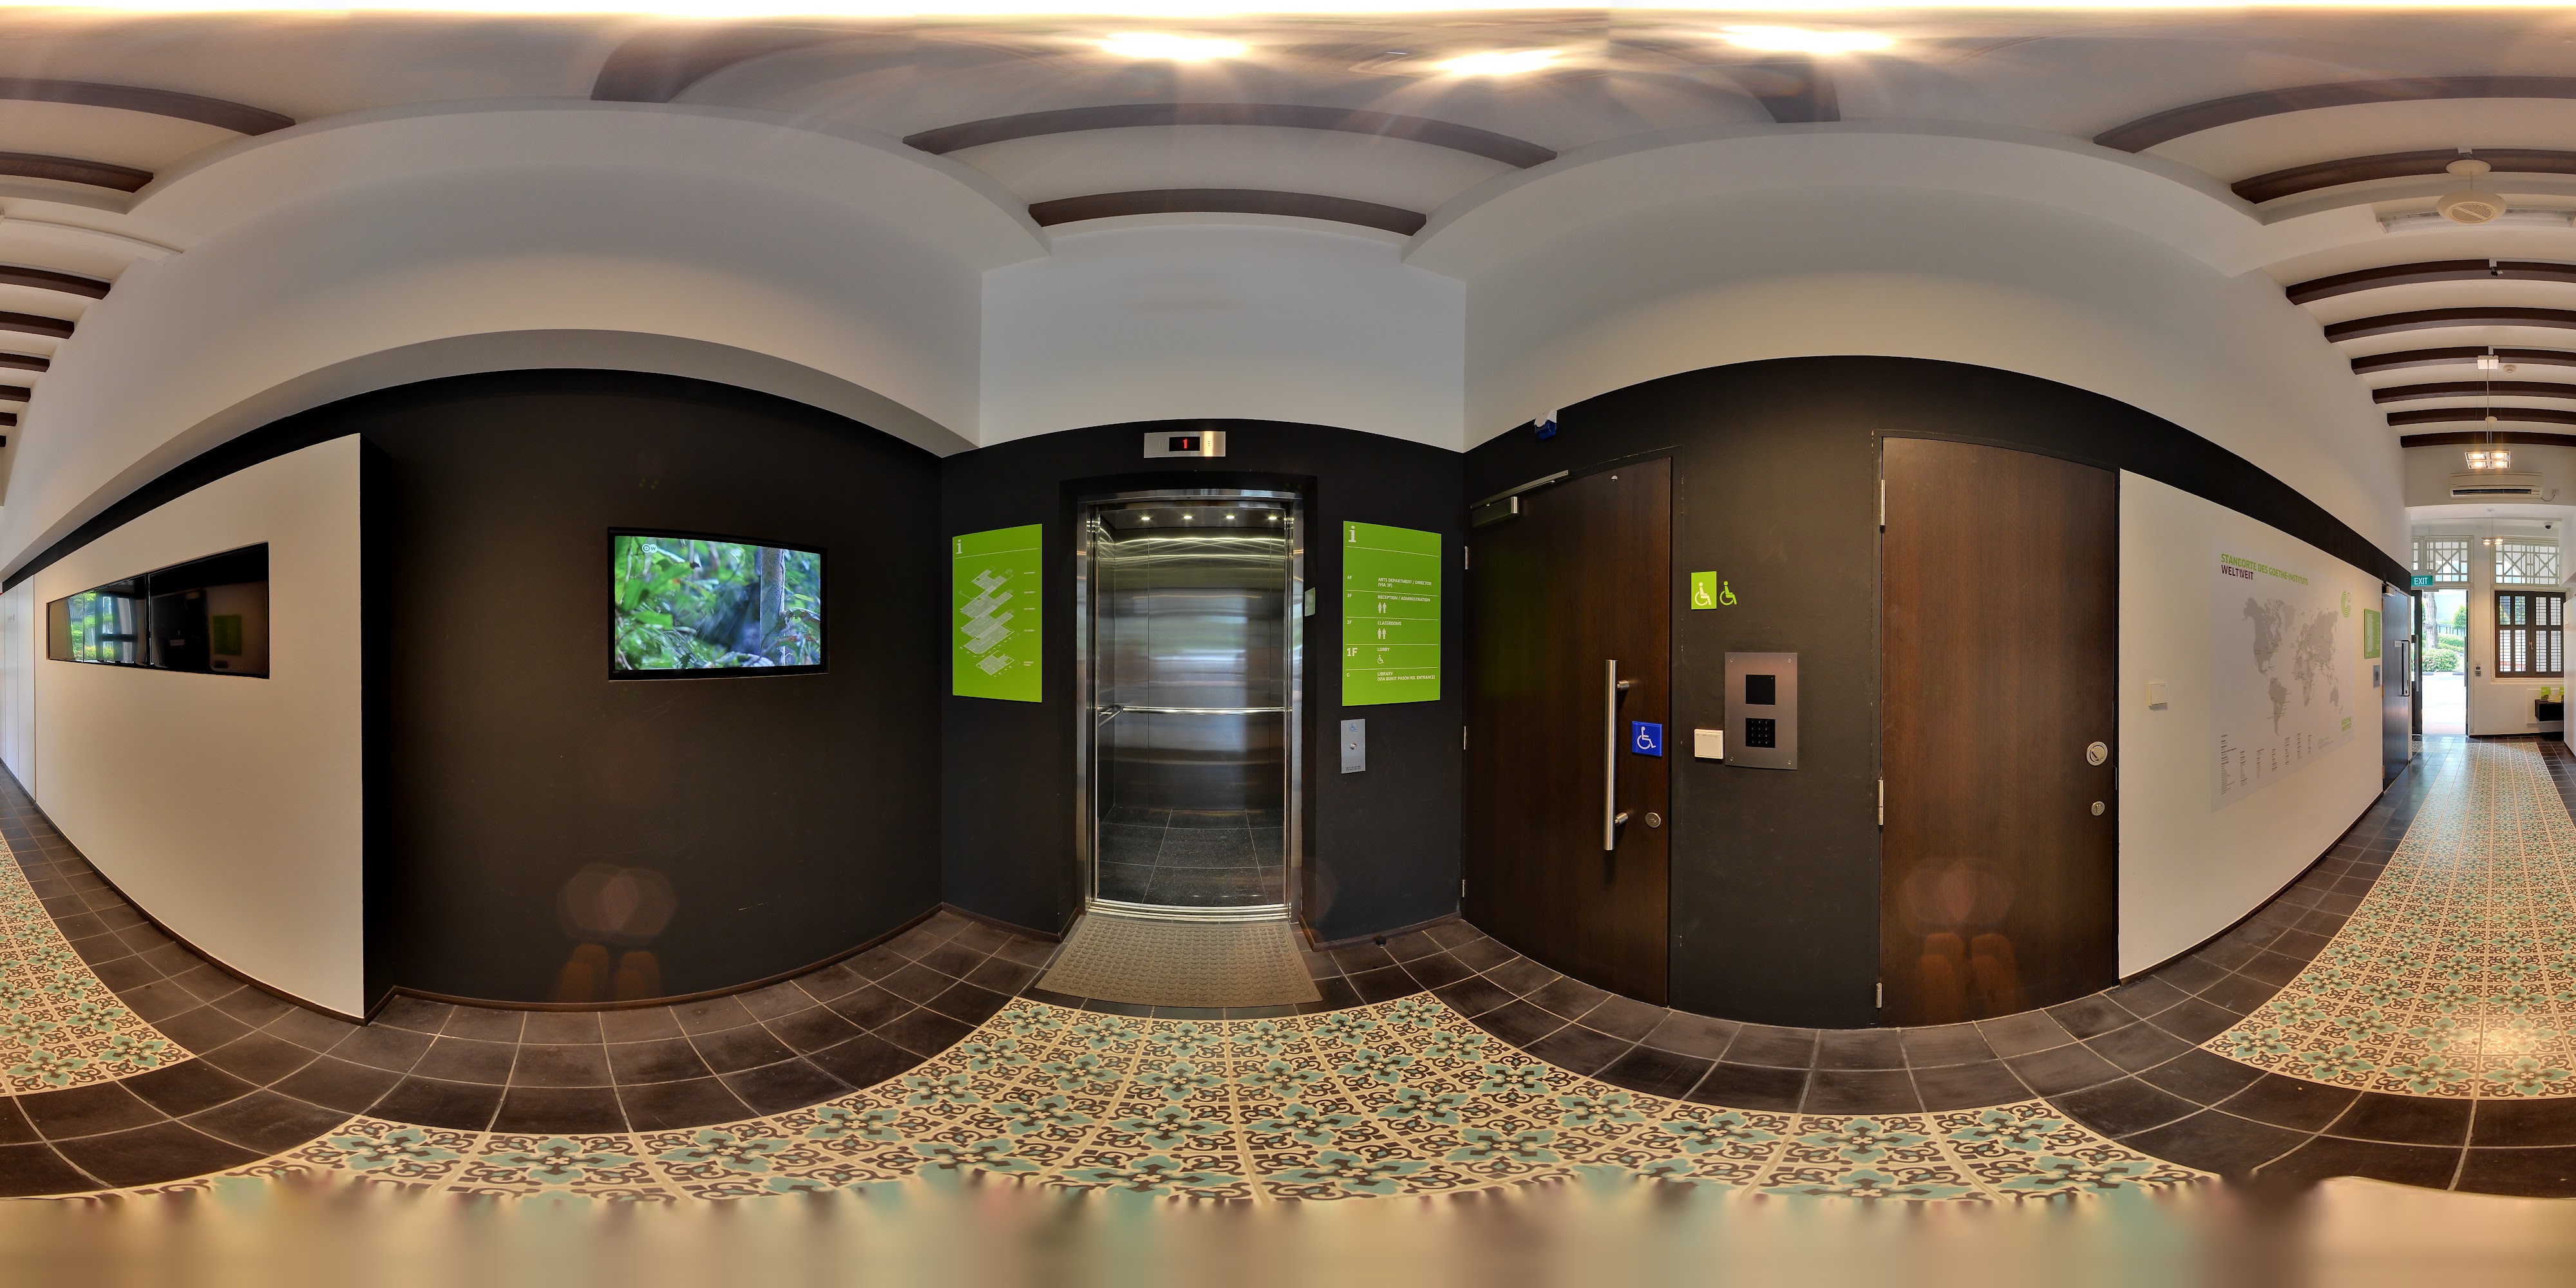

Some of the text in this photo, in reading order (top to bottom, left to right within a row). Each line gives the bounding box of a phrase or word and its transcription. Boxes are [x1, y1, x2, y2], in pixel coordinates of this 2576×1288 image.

[1183, 439, 1187, 449] 1
[2221, 554, 2308, 585] STANDORTE DES GOETHE-INSTITUTS
[2221, 565, 2254, 580] WELTWEIT
[1347, 648, 1358, 657] 1F
